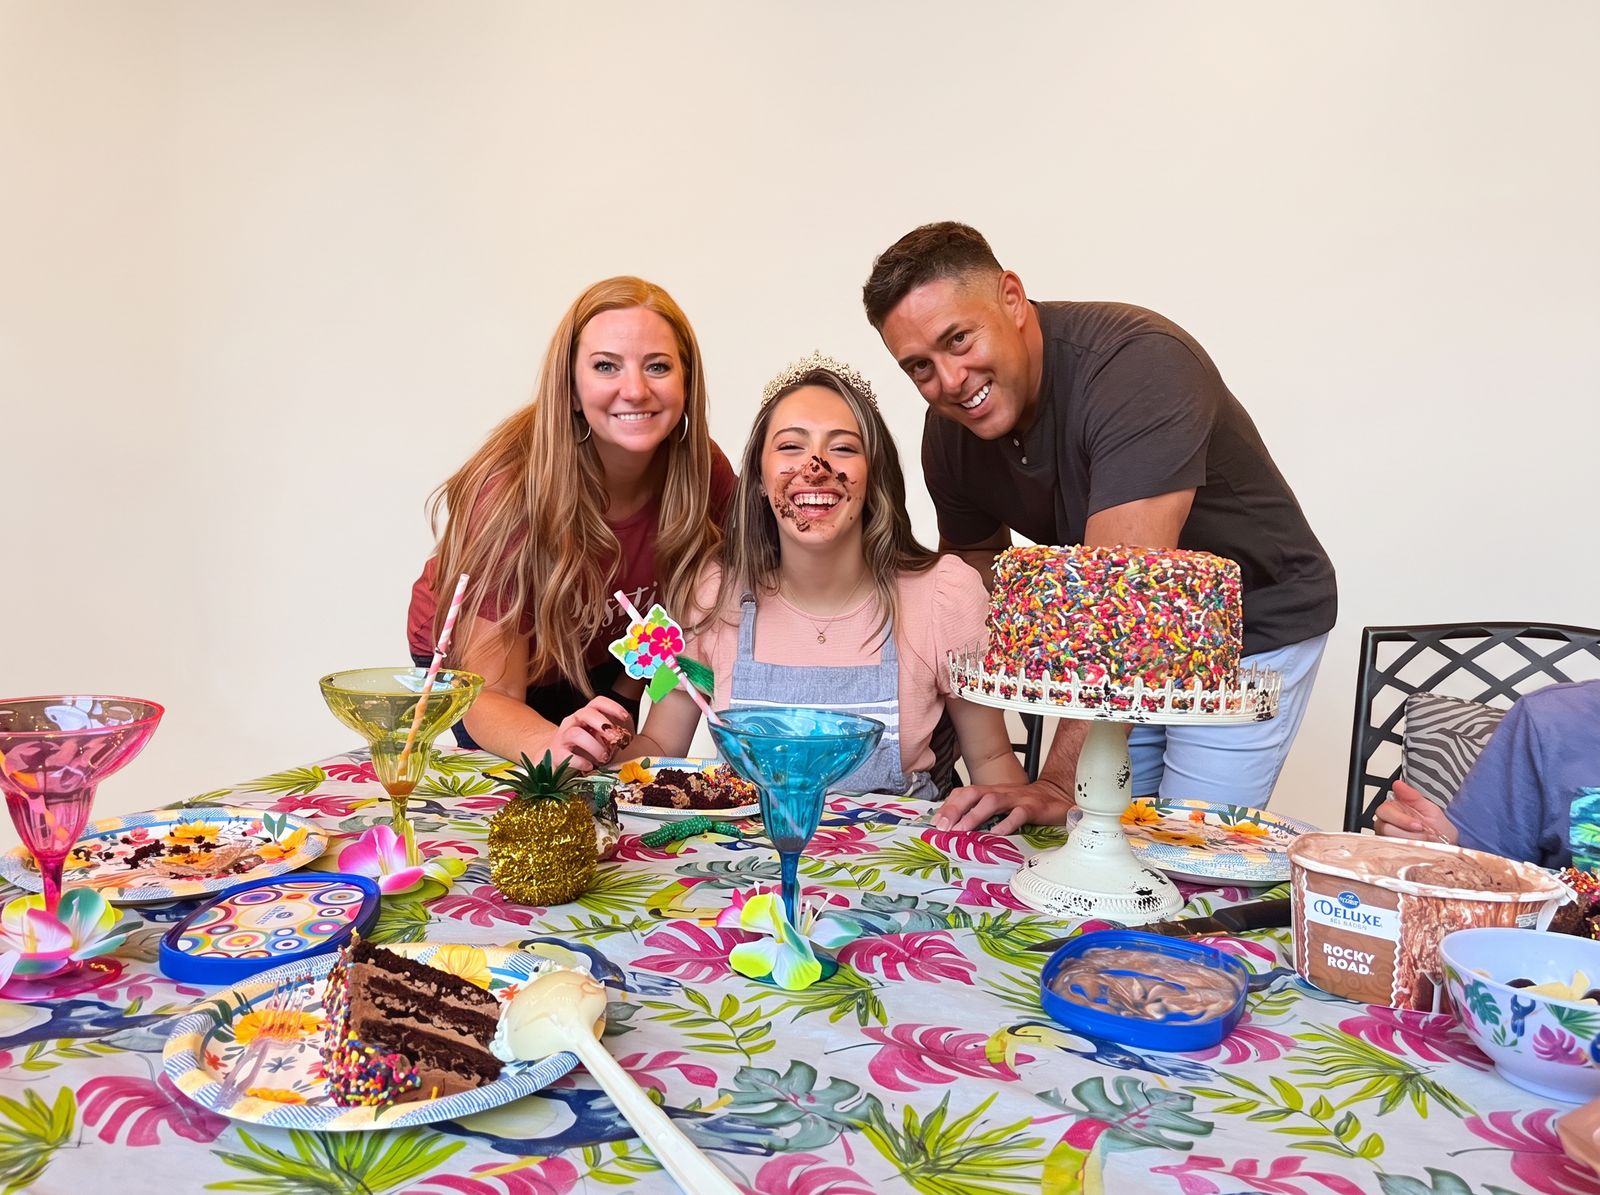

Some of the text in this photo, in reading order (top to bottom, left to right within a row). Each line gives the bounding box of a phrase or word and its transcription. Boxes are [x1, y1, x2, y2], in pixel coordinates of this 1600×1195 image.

[1314, 899, 1382, 928] DELUXE
[1323, 942, 1376, 965] ROCKY
[1327, 955, 1370, 975] ROAD
